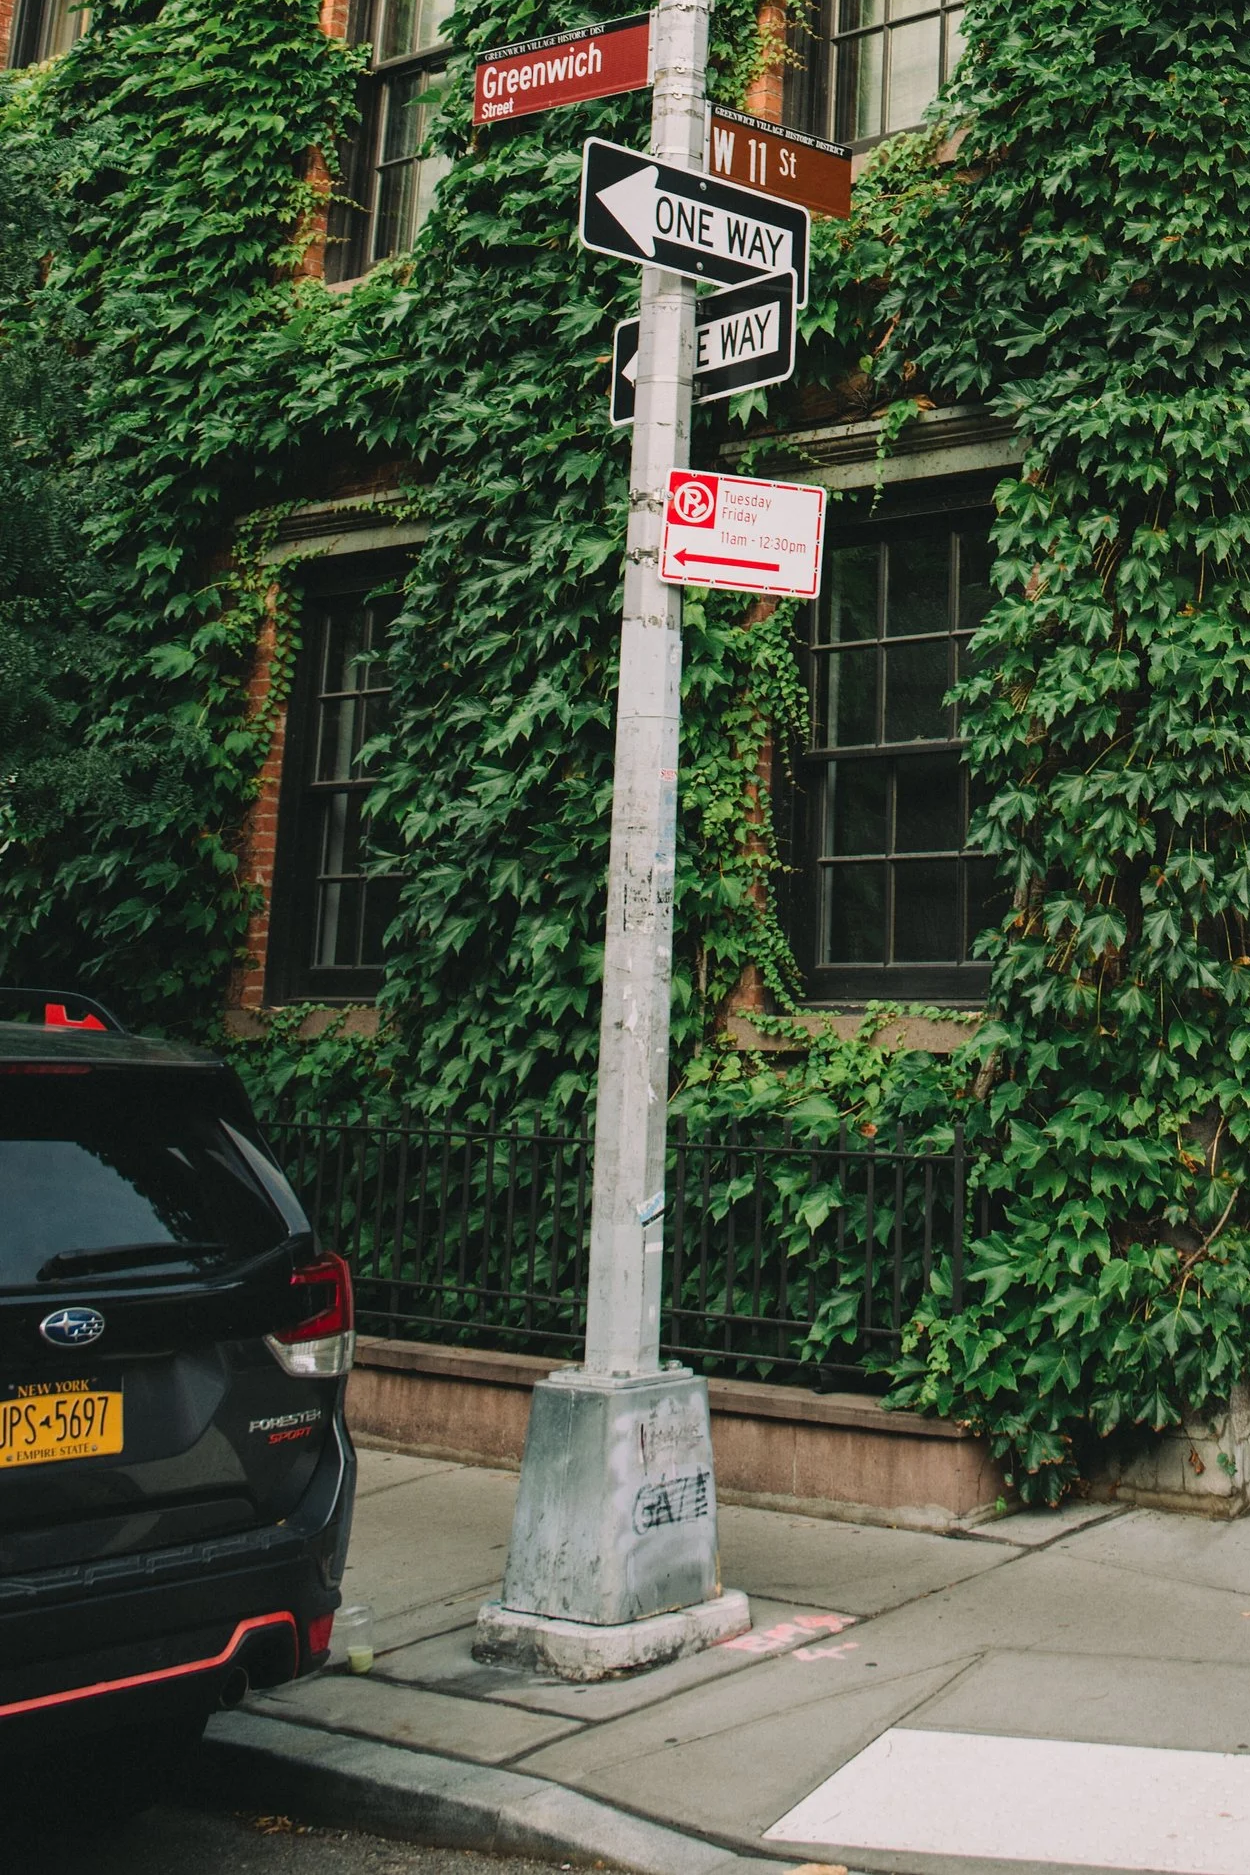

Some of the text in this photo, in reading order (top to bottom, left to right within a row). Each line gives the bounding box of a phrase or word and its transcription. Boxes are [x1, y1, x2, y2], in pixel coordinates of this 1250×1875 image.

[485, 25, 605, 61] GREENWICH VILLAGE HISTORIC DIST
[482, 42, 602, 99] Greenwich
[481, 98, 515, 119] Street
[714, 106, 845, 156] GREENWICH VILLAGE HISTORIC DISTRICT
[713, 126, 796, 186] W 11 St
[655, 196, 784, 267] ONE WAY
[721, 309, 772, 360] WAY
[723, 490, 772, 511] Tuesday
[721, 506, 757, 526] Friday
[721, 531, 747, 547] 11am
[759, 536, 807, 555] 12:30pm
[17, 1379, 90, 1398] NEW YORK
[55, 1396, 109, 1442] 5697
[248, 1409, 321, 1433] FORESTER
[268, 1425, 312, 1444] SPORT
[16, 1442, 91, 1461] EMPIRE STATE
